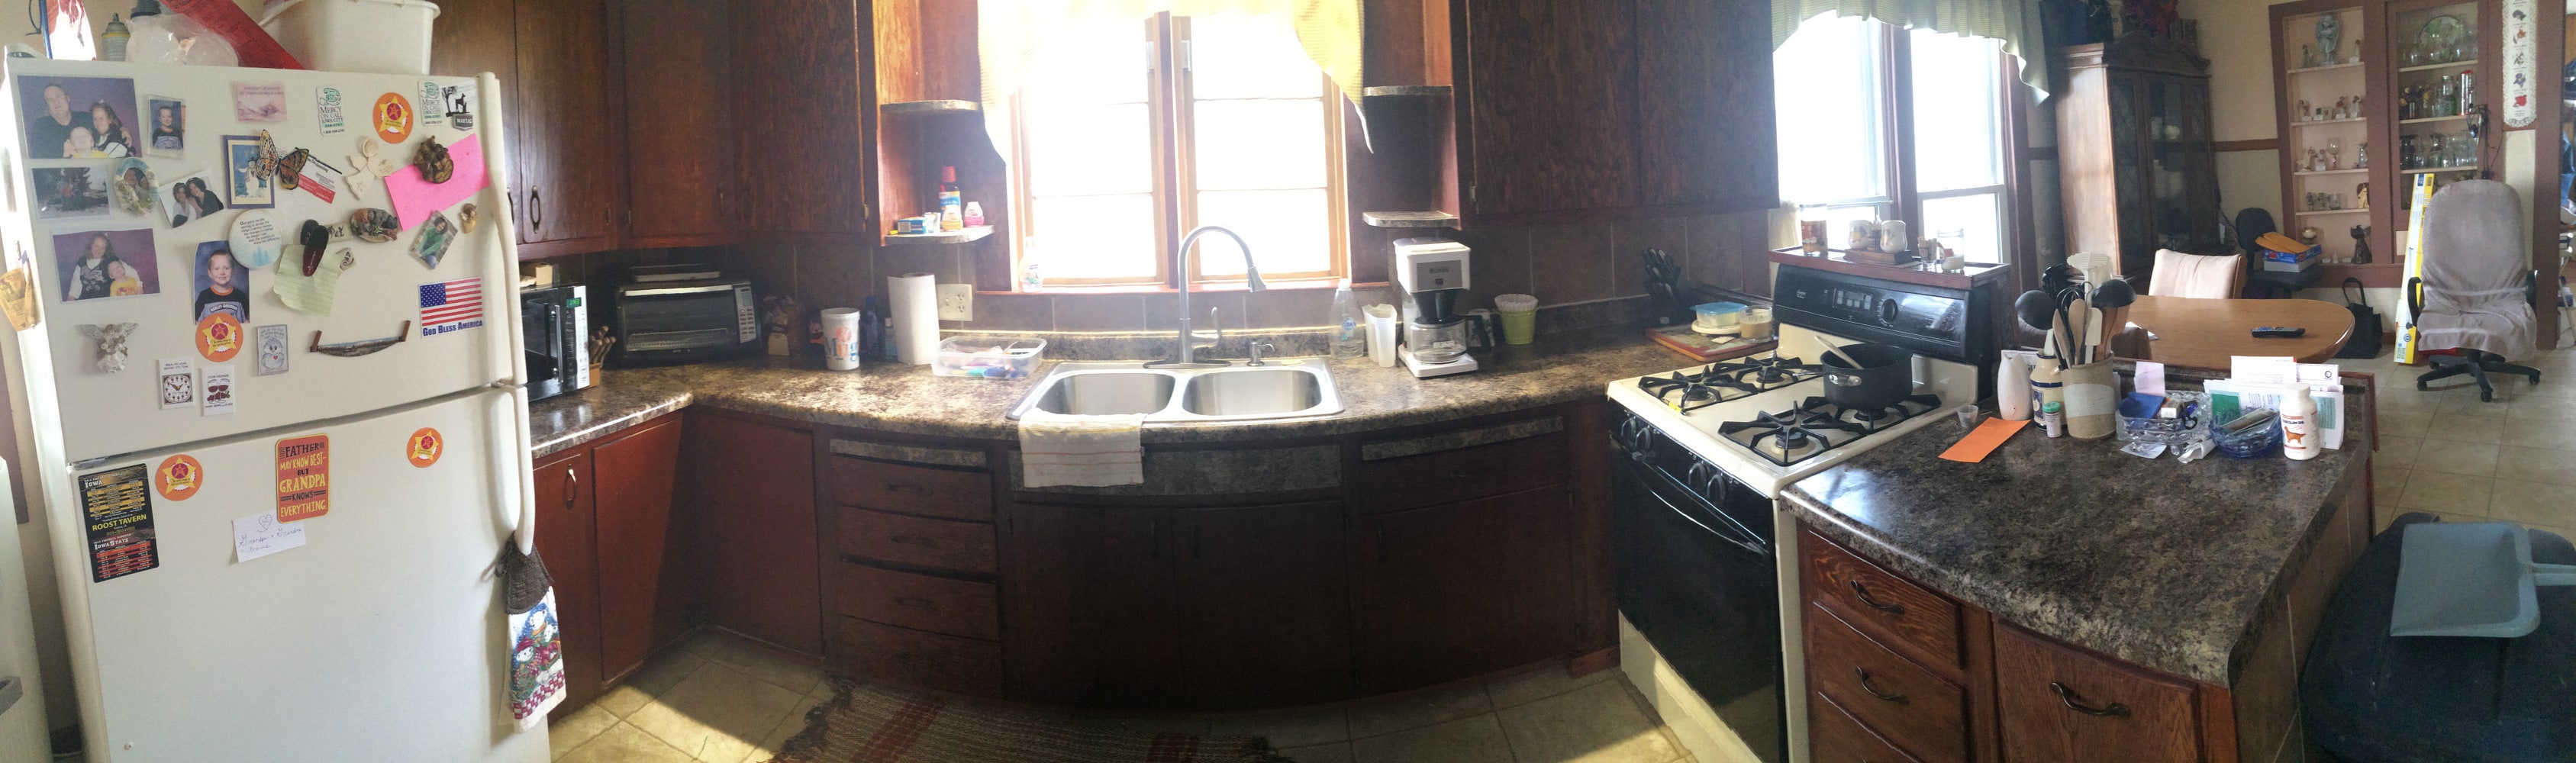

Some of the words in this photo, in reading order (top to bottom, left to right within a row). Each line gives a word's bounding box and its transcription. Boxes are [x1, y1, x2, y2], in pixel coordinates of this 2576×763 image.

[423, 327, 437, 336] GOD
[438, 325, 456, 333] BLESS
[458, 320, 482, 330] AMERICA
[285, 443, 319, 458] FATHER
[280, 459, 292, 471] MAY
[292, 456, 310, 469] KNOW
[85, 480, 102, 488] IOWA
[279, 474, 325, 493] GRANDPA
[292, 491, 314, 501] KNOWS
[92, 520, 118, 531] ROOST
[119, 514, 147, 524] TAVERN
[110, 538, 128, 546] STATE
